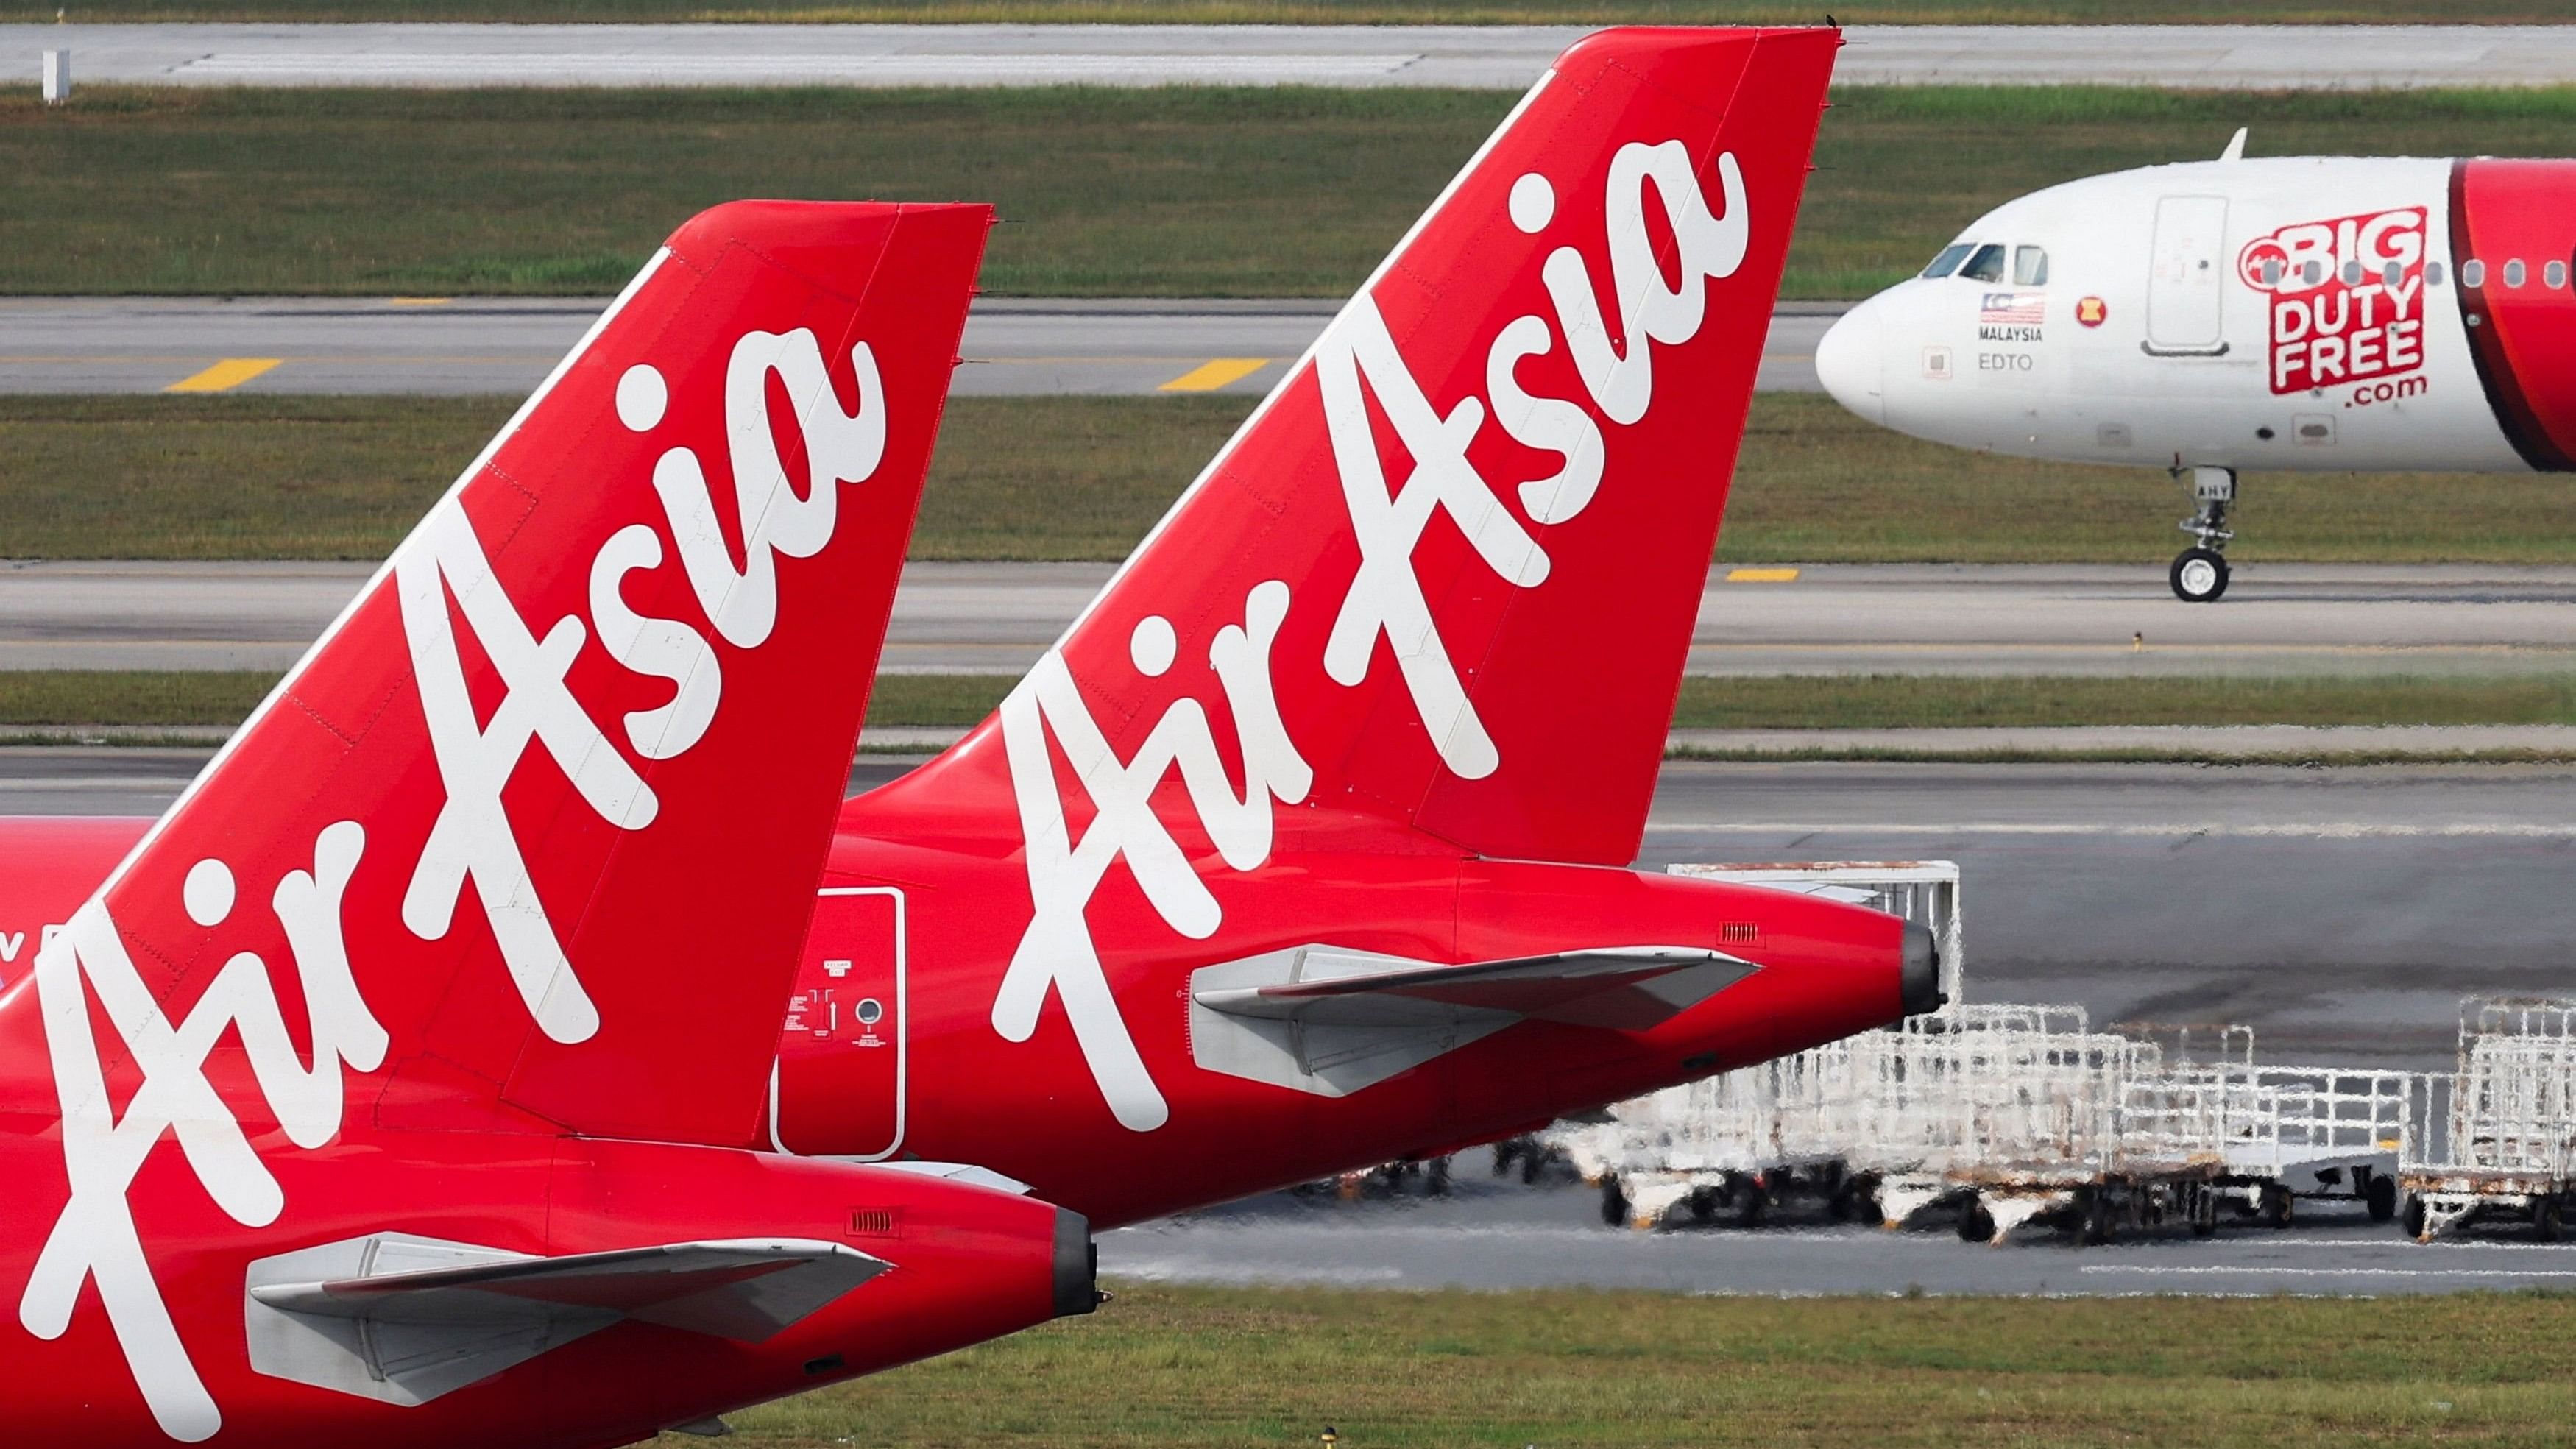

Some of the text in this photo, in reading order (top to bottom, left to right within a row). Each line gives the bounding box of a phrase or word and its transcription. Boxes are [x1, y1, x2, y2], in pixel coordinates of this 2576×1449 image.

[2277, 210, 2422, 293] BIG
[1978, 325, 2042, 341] MALAYSIA
[2275, 275, 2420, 343] DUTY
[1979, 353, 2033, 371] EDTO
[2276, 319, 2420, 388] FREE
[2344, 376, 2427, 408] .com
